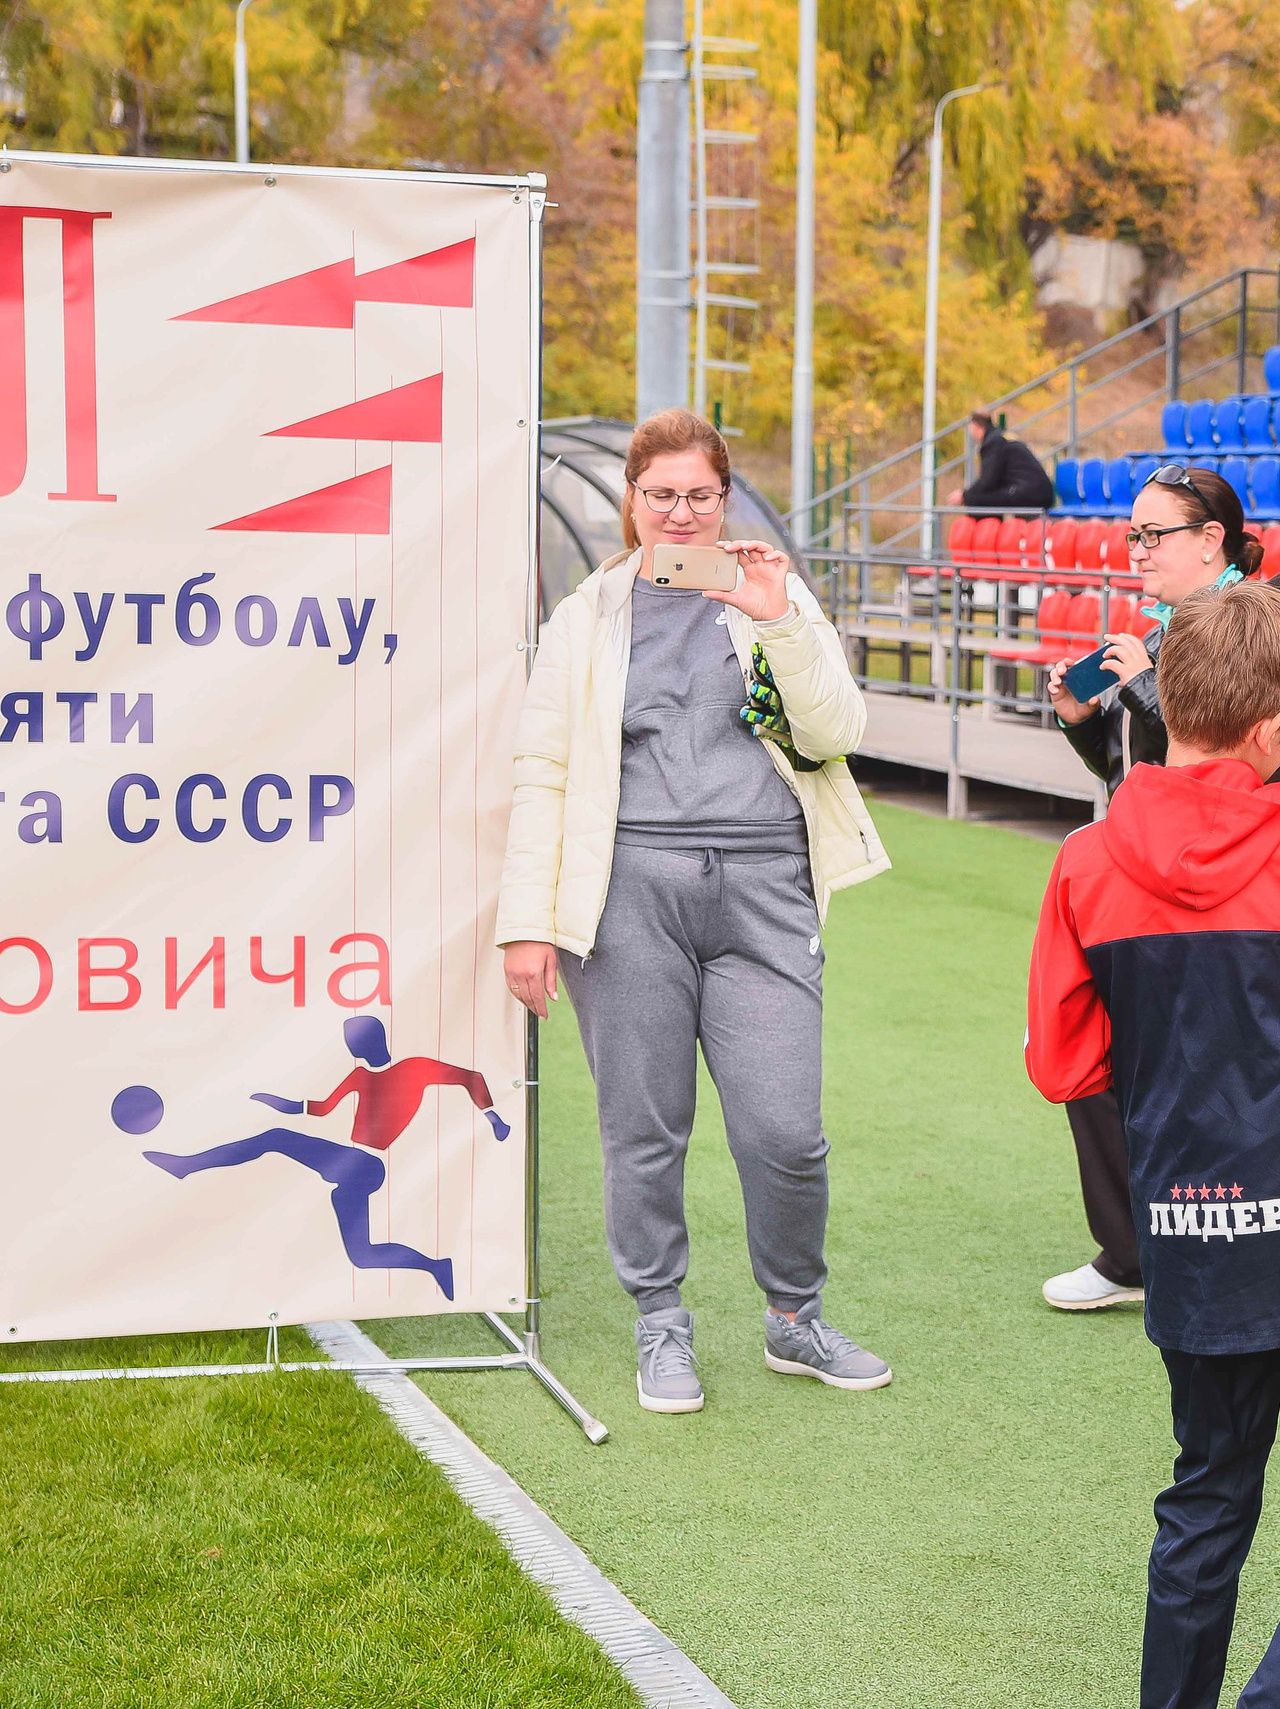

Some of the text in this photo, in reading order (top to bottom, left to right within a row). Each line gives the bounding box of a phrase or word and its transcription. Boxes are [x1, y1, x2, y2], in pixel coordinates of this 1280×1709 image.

[5, 572, 398, 664] футболу,
[0, 691, 154, 744] яти
[0, 773, 355, 844] а СССР
[0, 932, 392, 1014] овича
